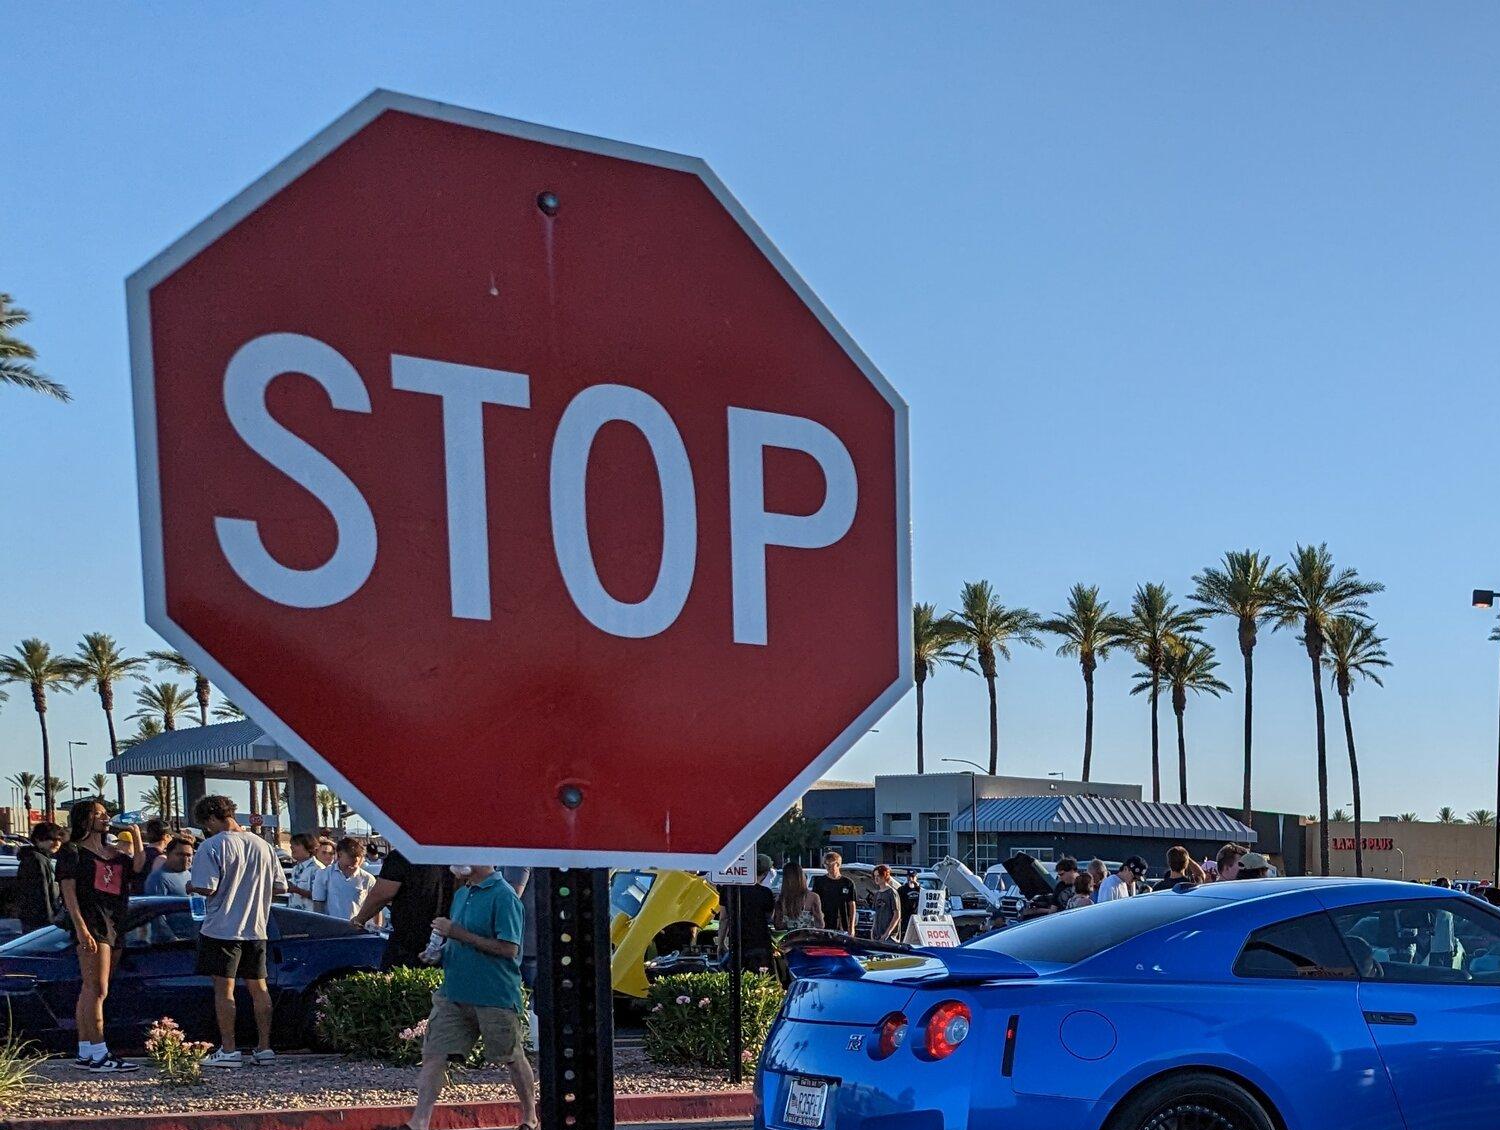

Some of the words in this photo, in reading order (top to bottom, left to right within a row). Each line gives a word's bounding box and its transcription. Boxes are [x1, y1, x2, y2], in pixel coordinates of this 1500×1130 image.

[215, 332, 858, 646] STOP
[1332, 837, 1367, 850] LAMS
[1368, 837, 1393, 850] PLUS
[926, 892, 940, 900] 1987
[927, 930, 950, 938] ROCK
